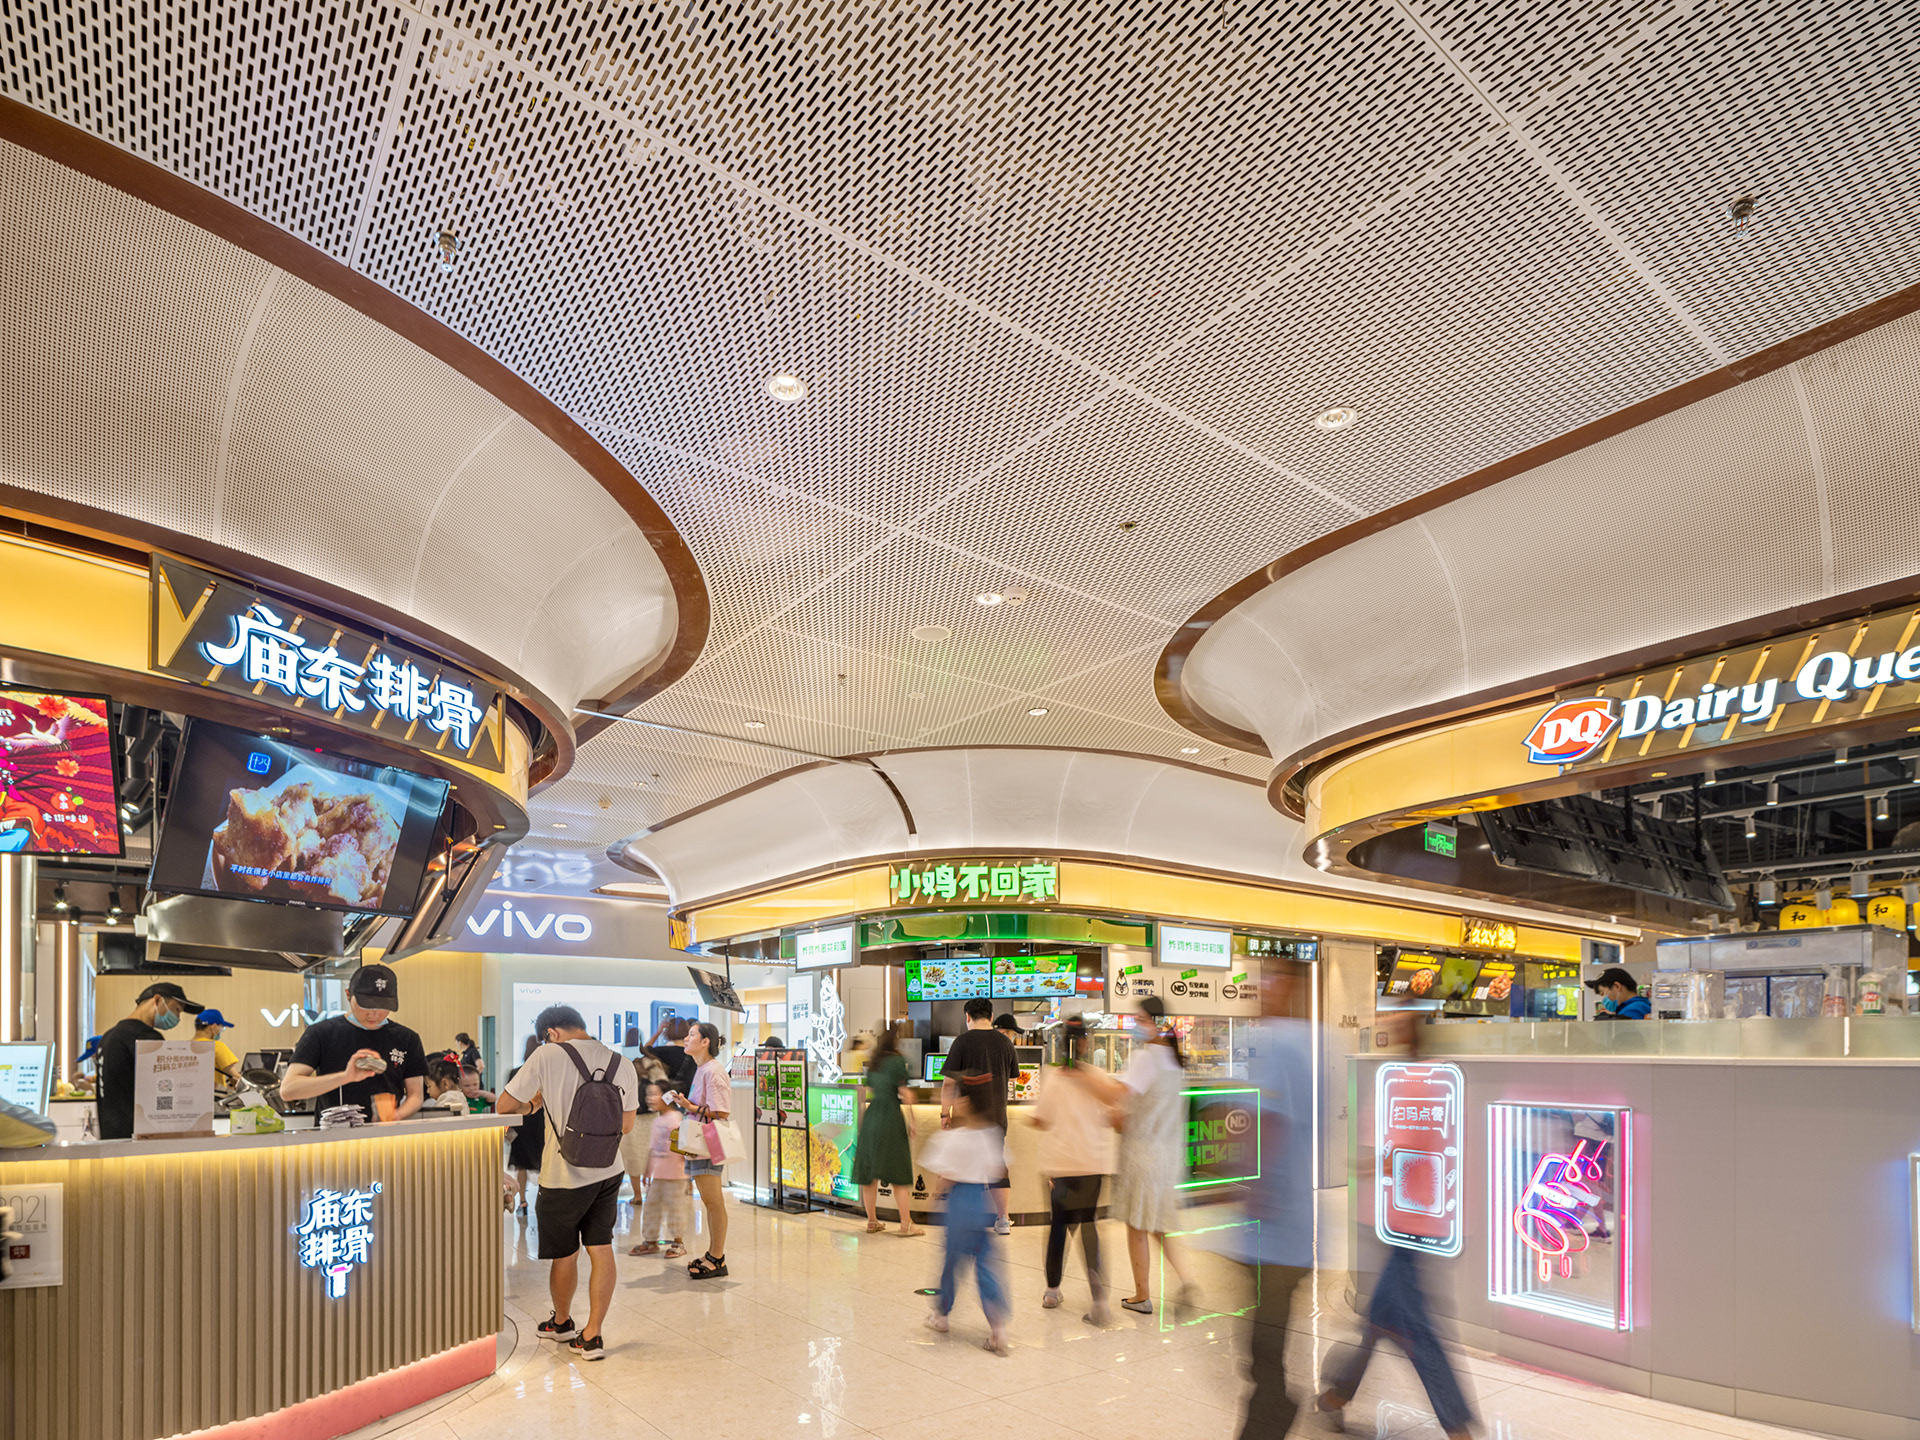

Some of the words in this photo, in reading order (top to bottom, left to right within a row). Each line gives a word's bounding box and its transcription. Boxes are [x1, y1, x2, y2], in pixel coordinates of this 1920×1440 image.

[201, 604, 482, 749] 庙东排骨
[1618, 678, 1779, 740] Dairy
[890, 864, 1057, 898] 小鸡不回家
[466, 900, 592, 942] vivo
[1790, 911, 1807, 925] 和
[1873, 903, 1889, 918] 和
[1168, 939, 1225, 955] 炸鸡炸串共和国
[821, 1093, 854, 1111] NONO
[1393, 1105, 1445, 1122] 扫码点餐
[1229, 1115, 1247, 1128] NO
[0, 1195, 47, 1225] 021
[295, 1188, 376, 1235] 庙东
[298, 1223, 375, 1268] 排骨
